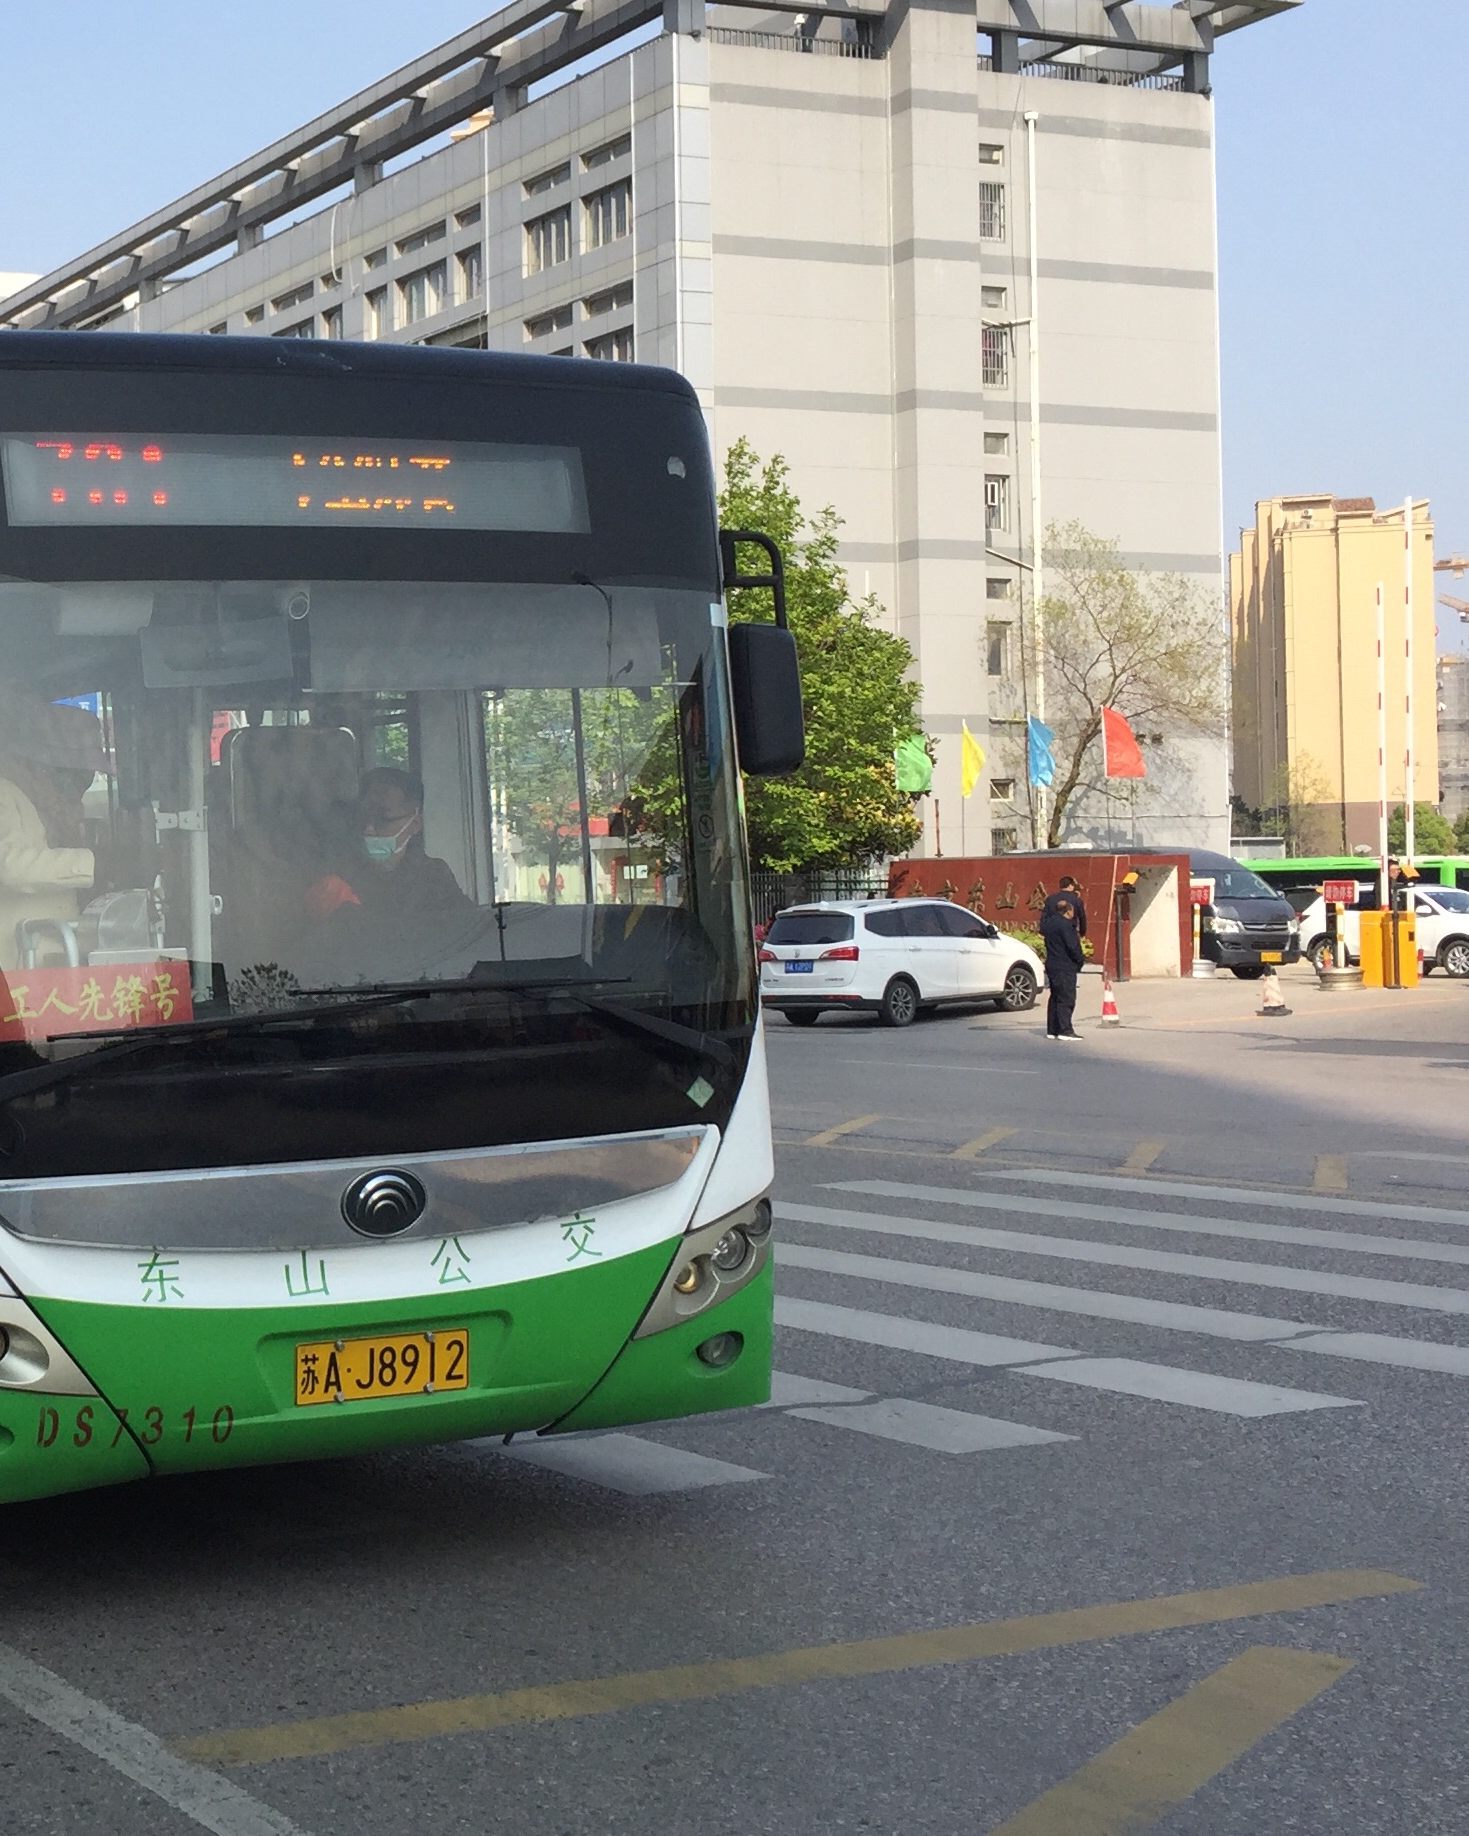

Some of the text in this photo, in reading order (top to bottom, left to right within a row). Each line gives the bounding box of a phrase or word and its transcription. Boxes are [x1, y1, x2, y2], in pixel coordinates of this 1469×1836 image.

[137, 1212, 604, 1303] 东山公交
[37, 1405, 234, 1448] DS7310
